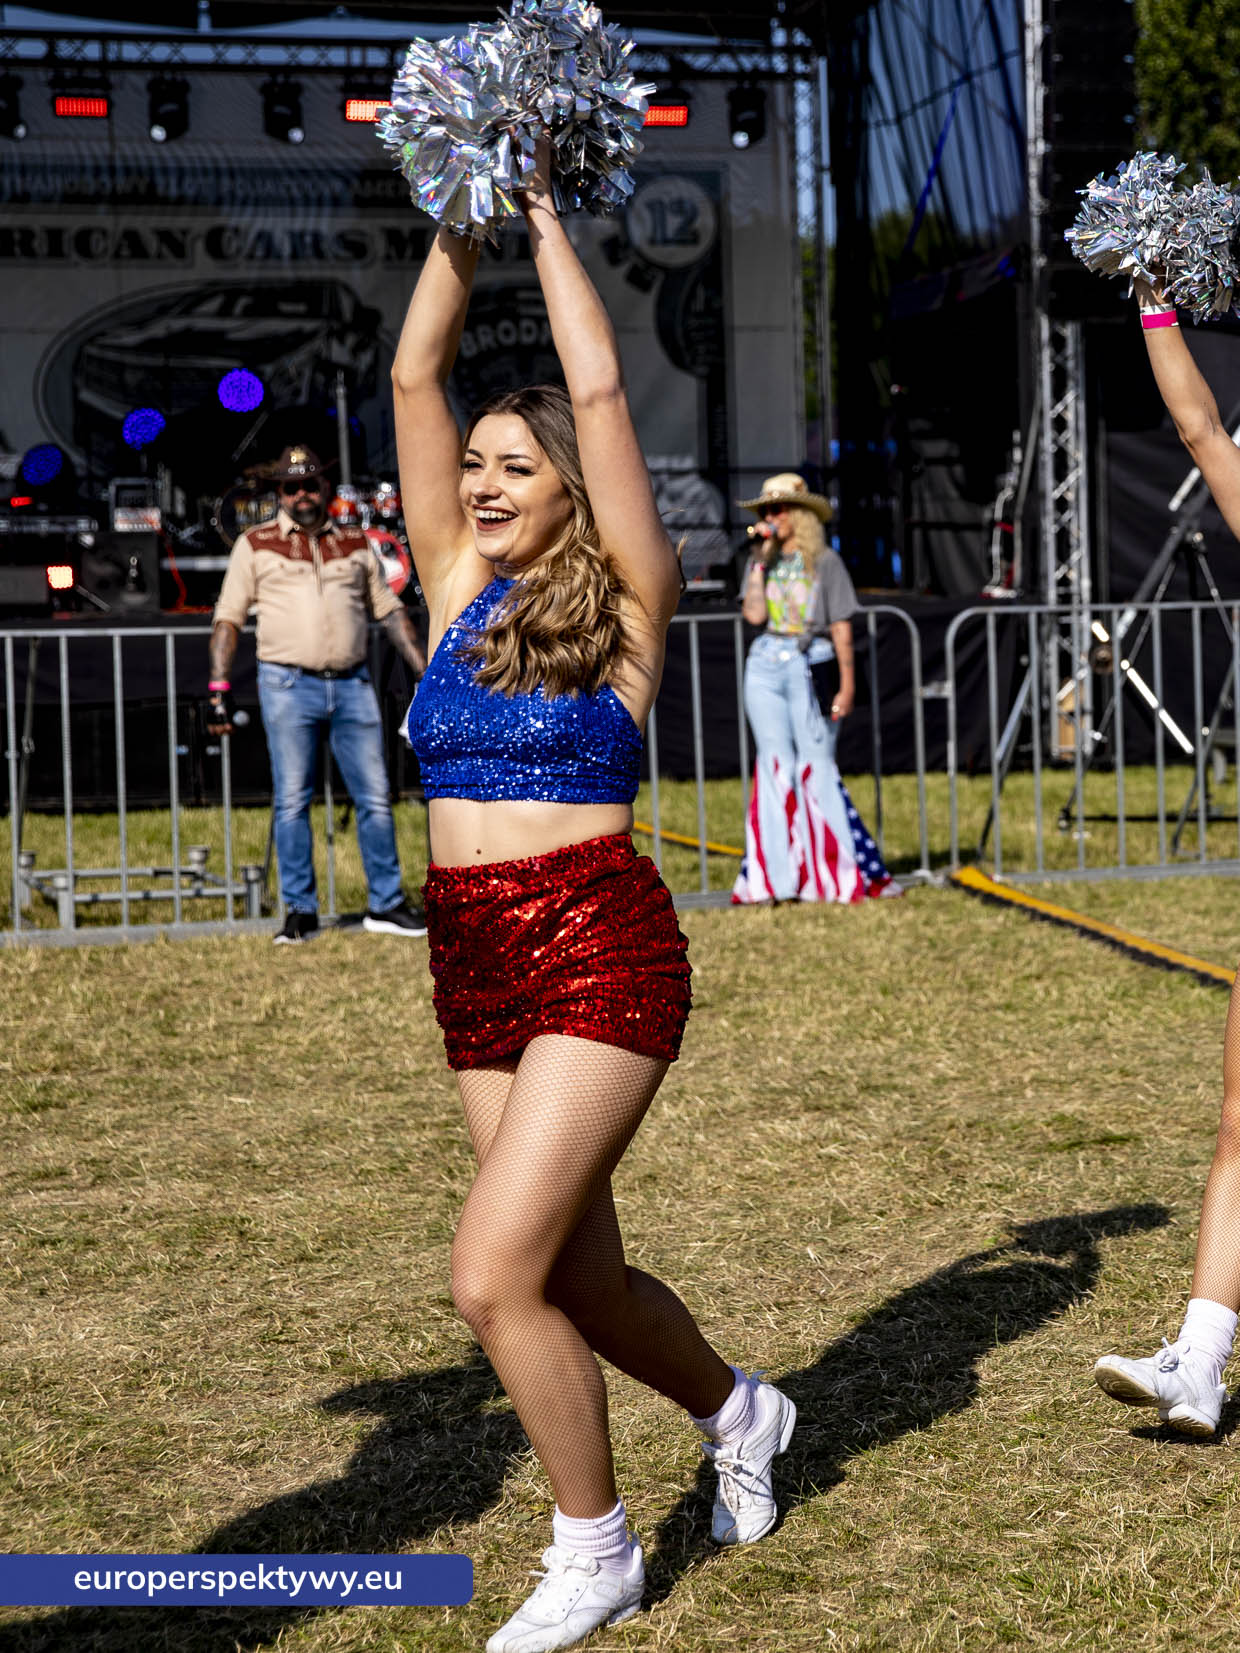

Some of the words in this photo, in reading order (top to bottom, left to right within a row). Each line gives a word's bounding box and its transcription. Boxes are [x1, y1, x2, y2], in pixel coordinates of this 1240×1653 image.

[0, 226, 194, 260] RICAN
[202, 224, 373, 262] CARS
[646, 198, 702, 247] 12
